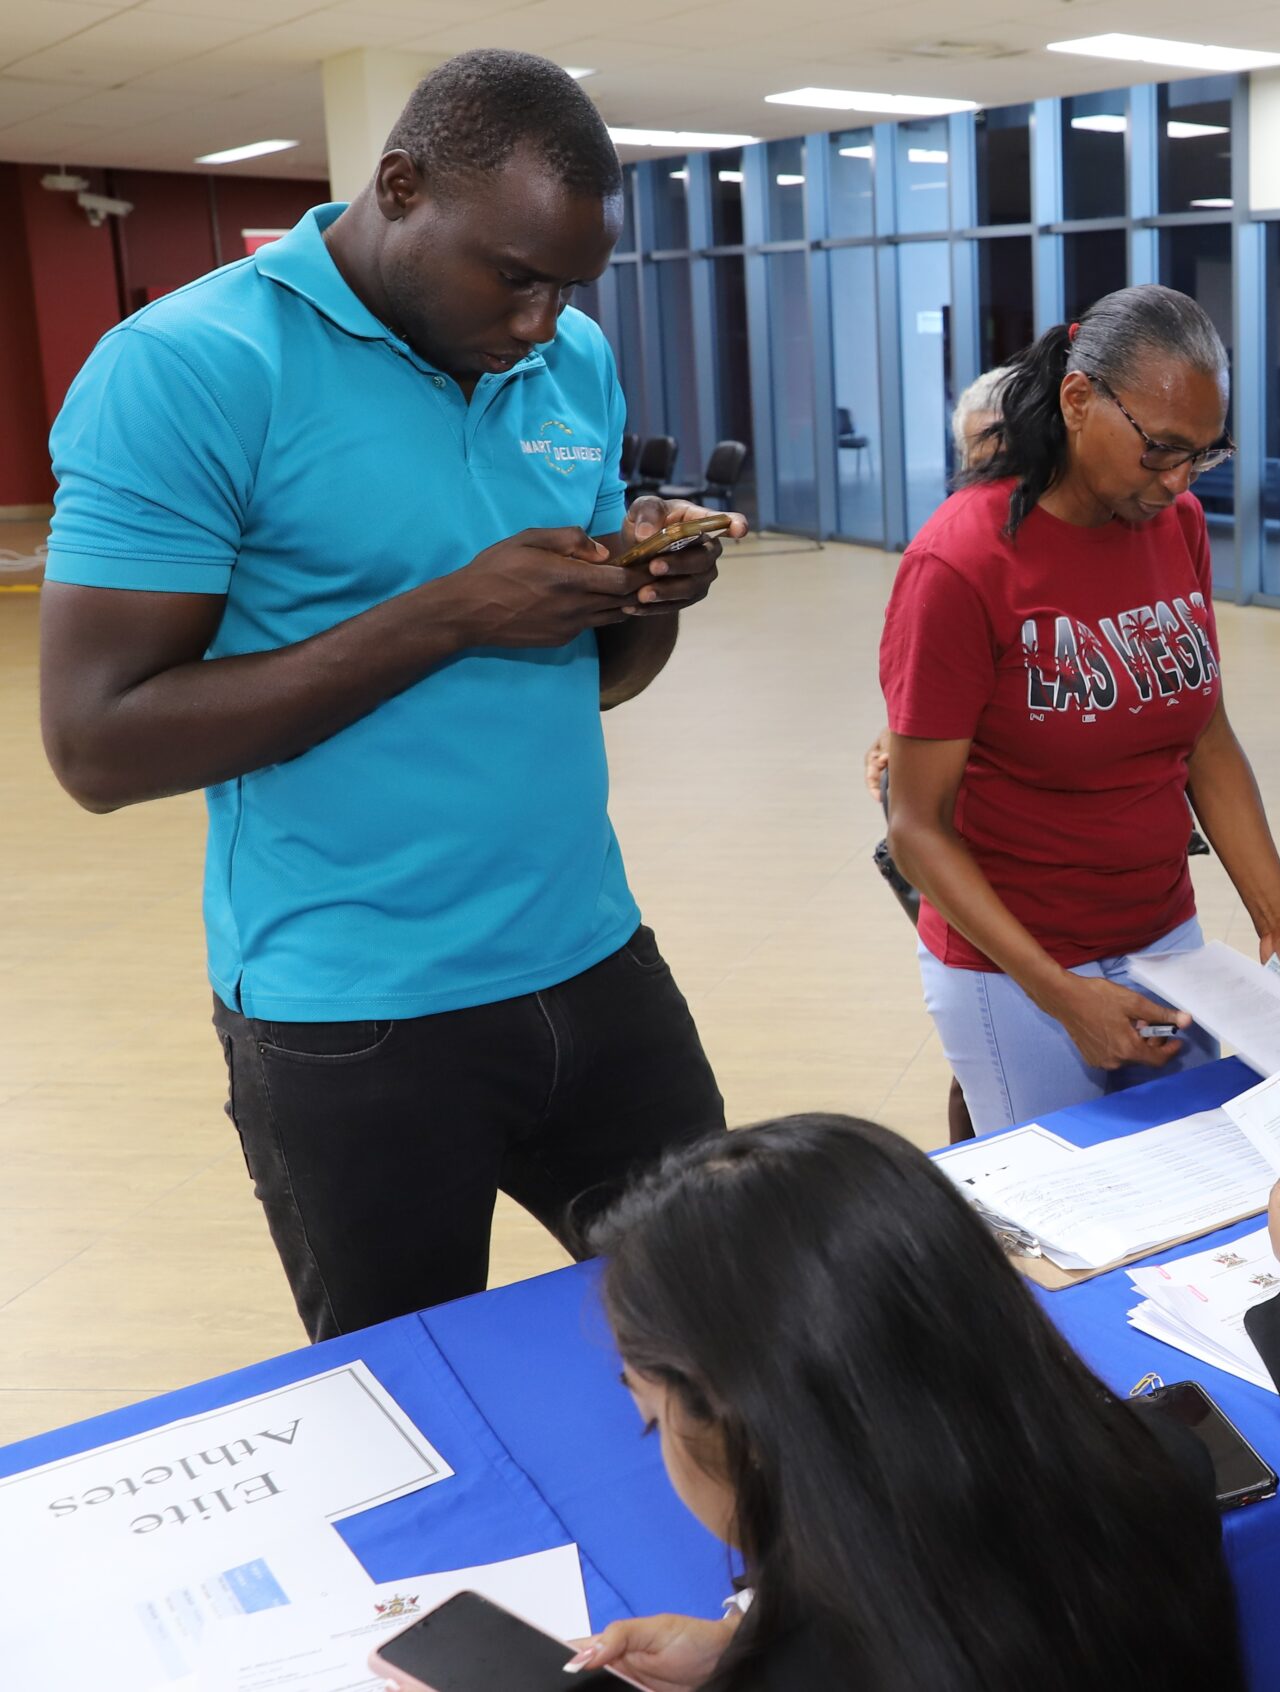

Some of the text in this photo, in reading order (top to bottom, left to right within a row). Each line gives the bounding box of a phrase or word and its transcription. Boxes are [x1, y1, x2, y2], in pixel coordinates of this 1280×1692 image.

[1021, 591, 1218, 711] LAS VEGA
[1029, 686, 1213, 723] NEVAD
[48, 1417, 303, 1518] Athletes
[129, 1470, 287, 1534] Elite
